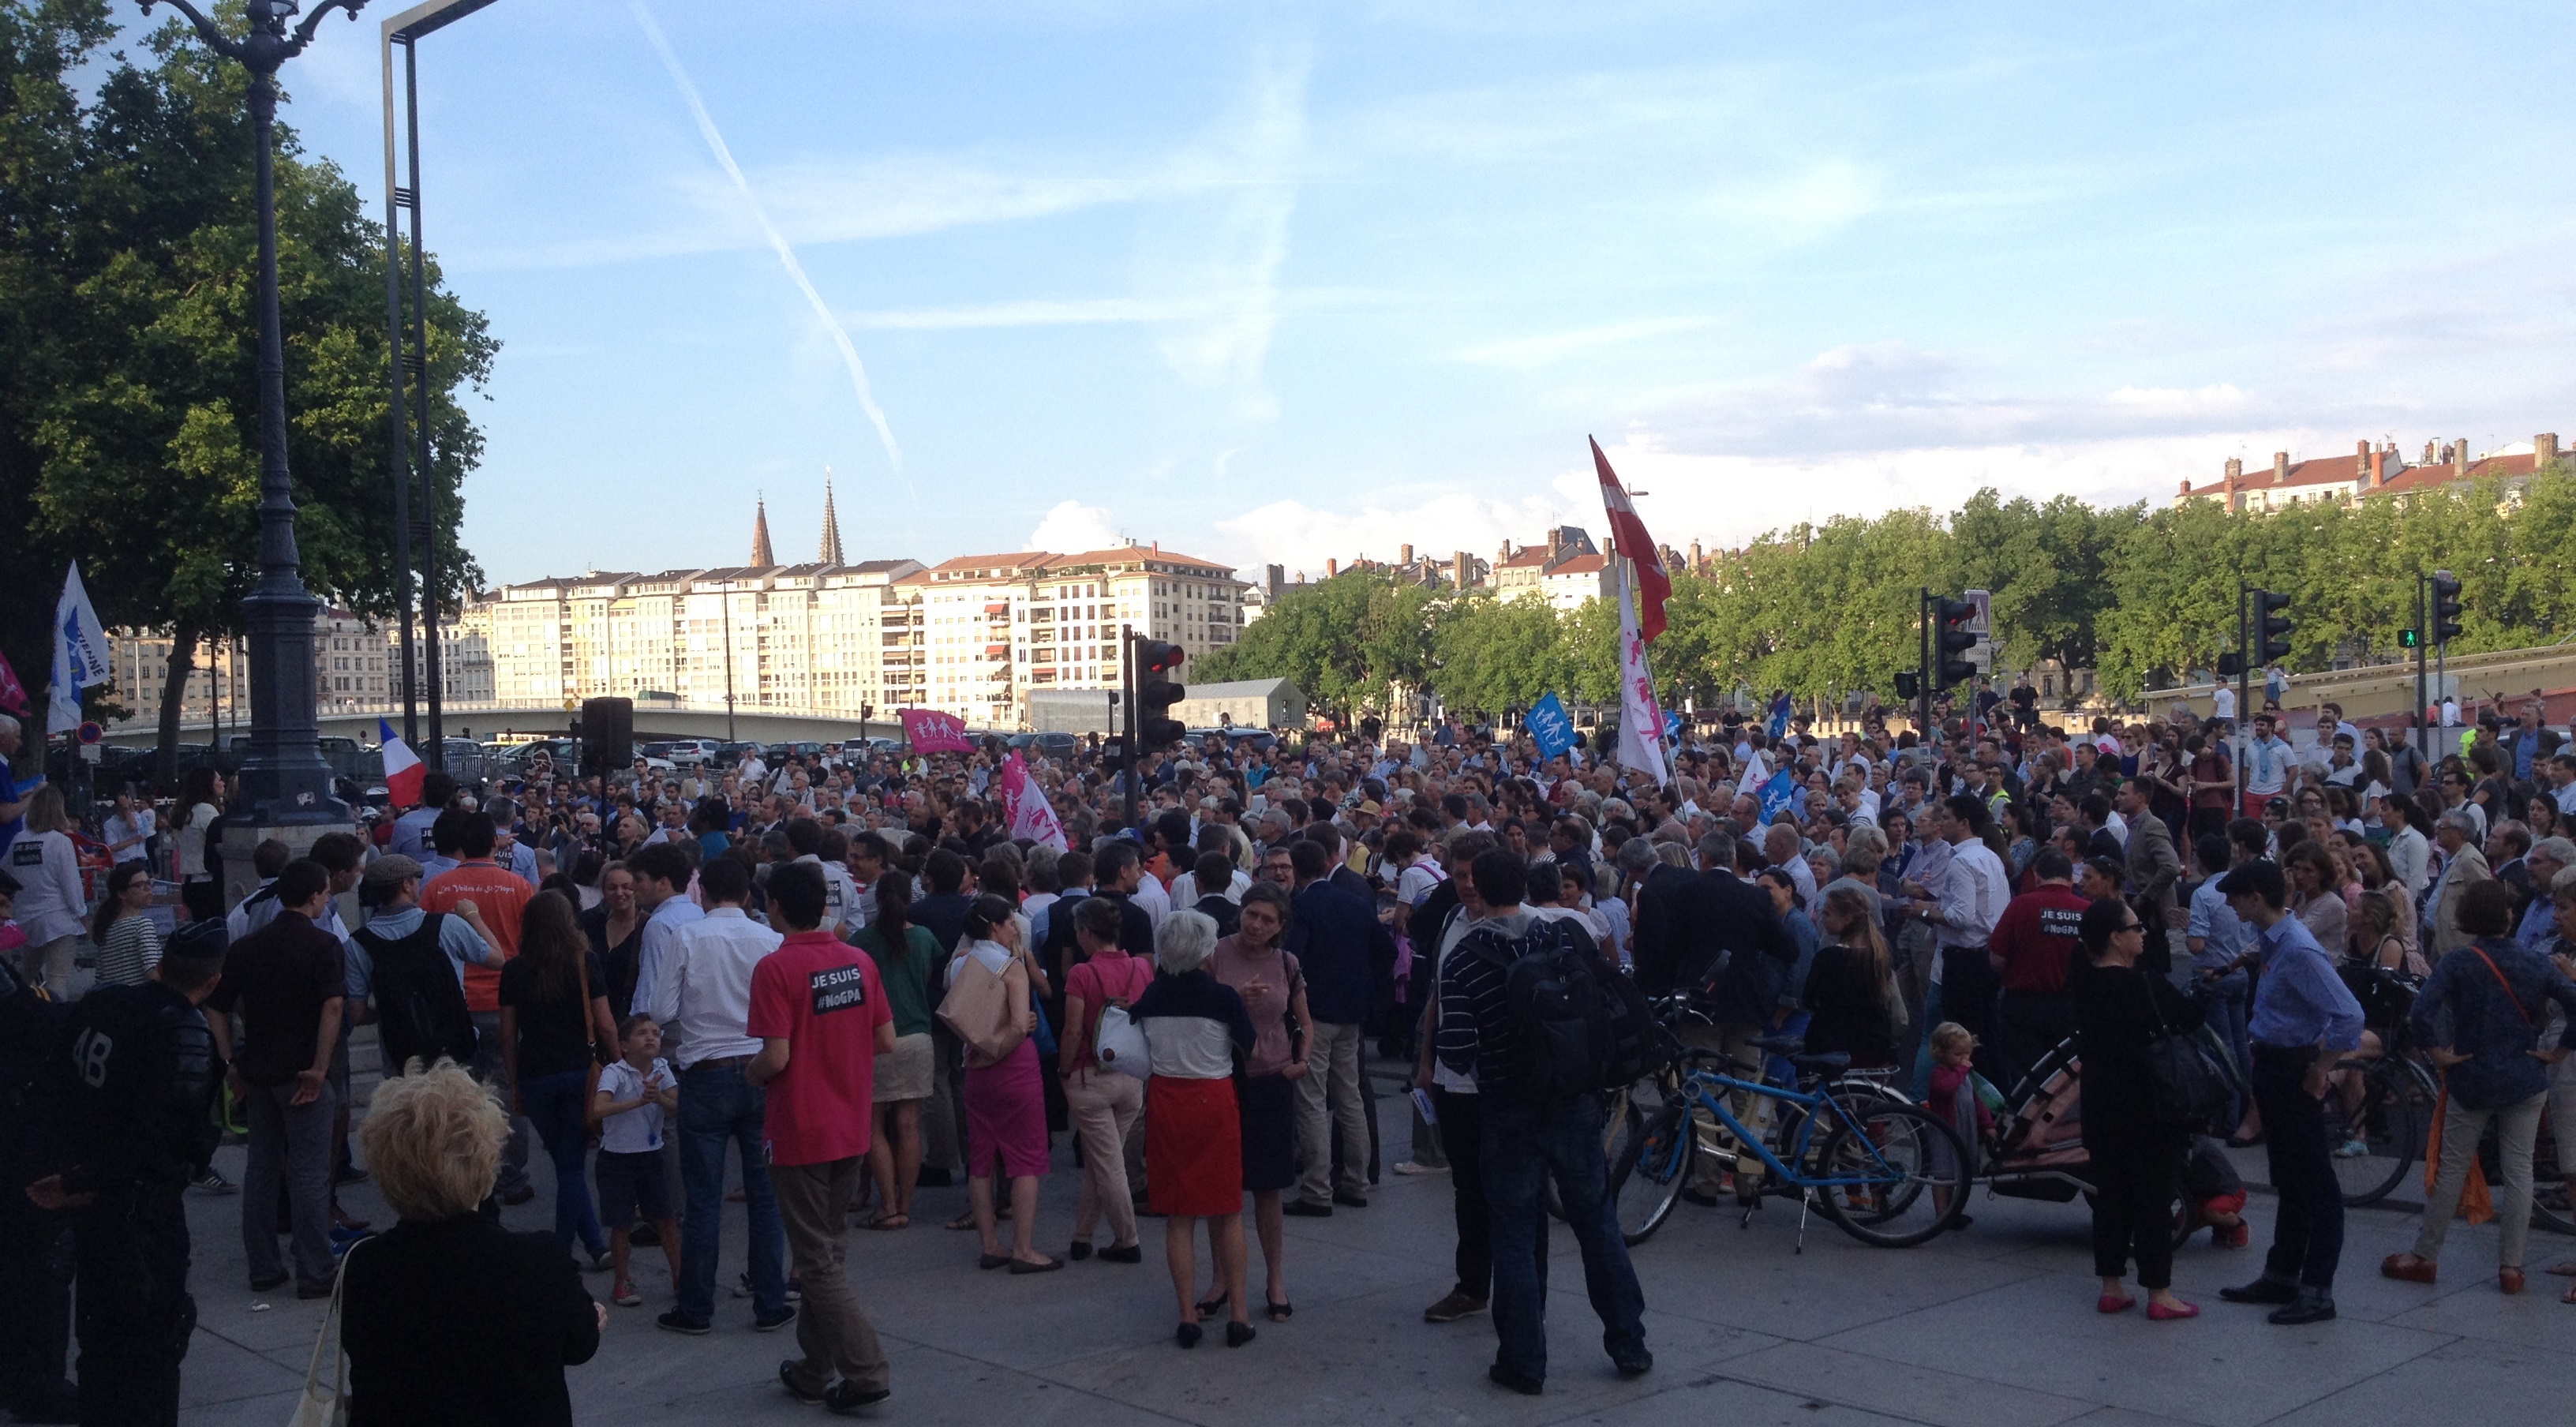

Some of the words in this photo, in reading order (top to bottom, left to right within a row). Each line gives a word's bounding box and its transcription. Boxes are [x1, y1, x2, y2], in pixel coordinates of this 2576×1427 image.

[2041, 910, 2054, 919] JE
[2057, 912, 2082, 921] SUIS
[2044, 924, 2079, 935] #NoGPA
[812, 975, 828, 989] JE
[829, 968, 861, 986] SUIS
[817, 988, 862, 1009] #NoGPA
